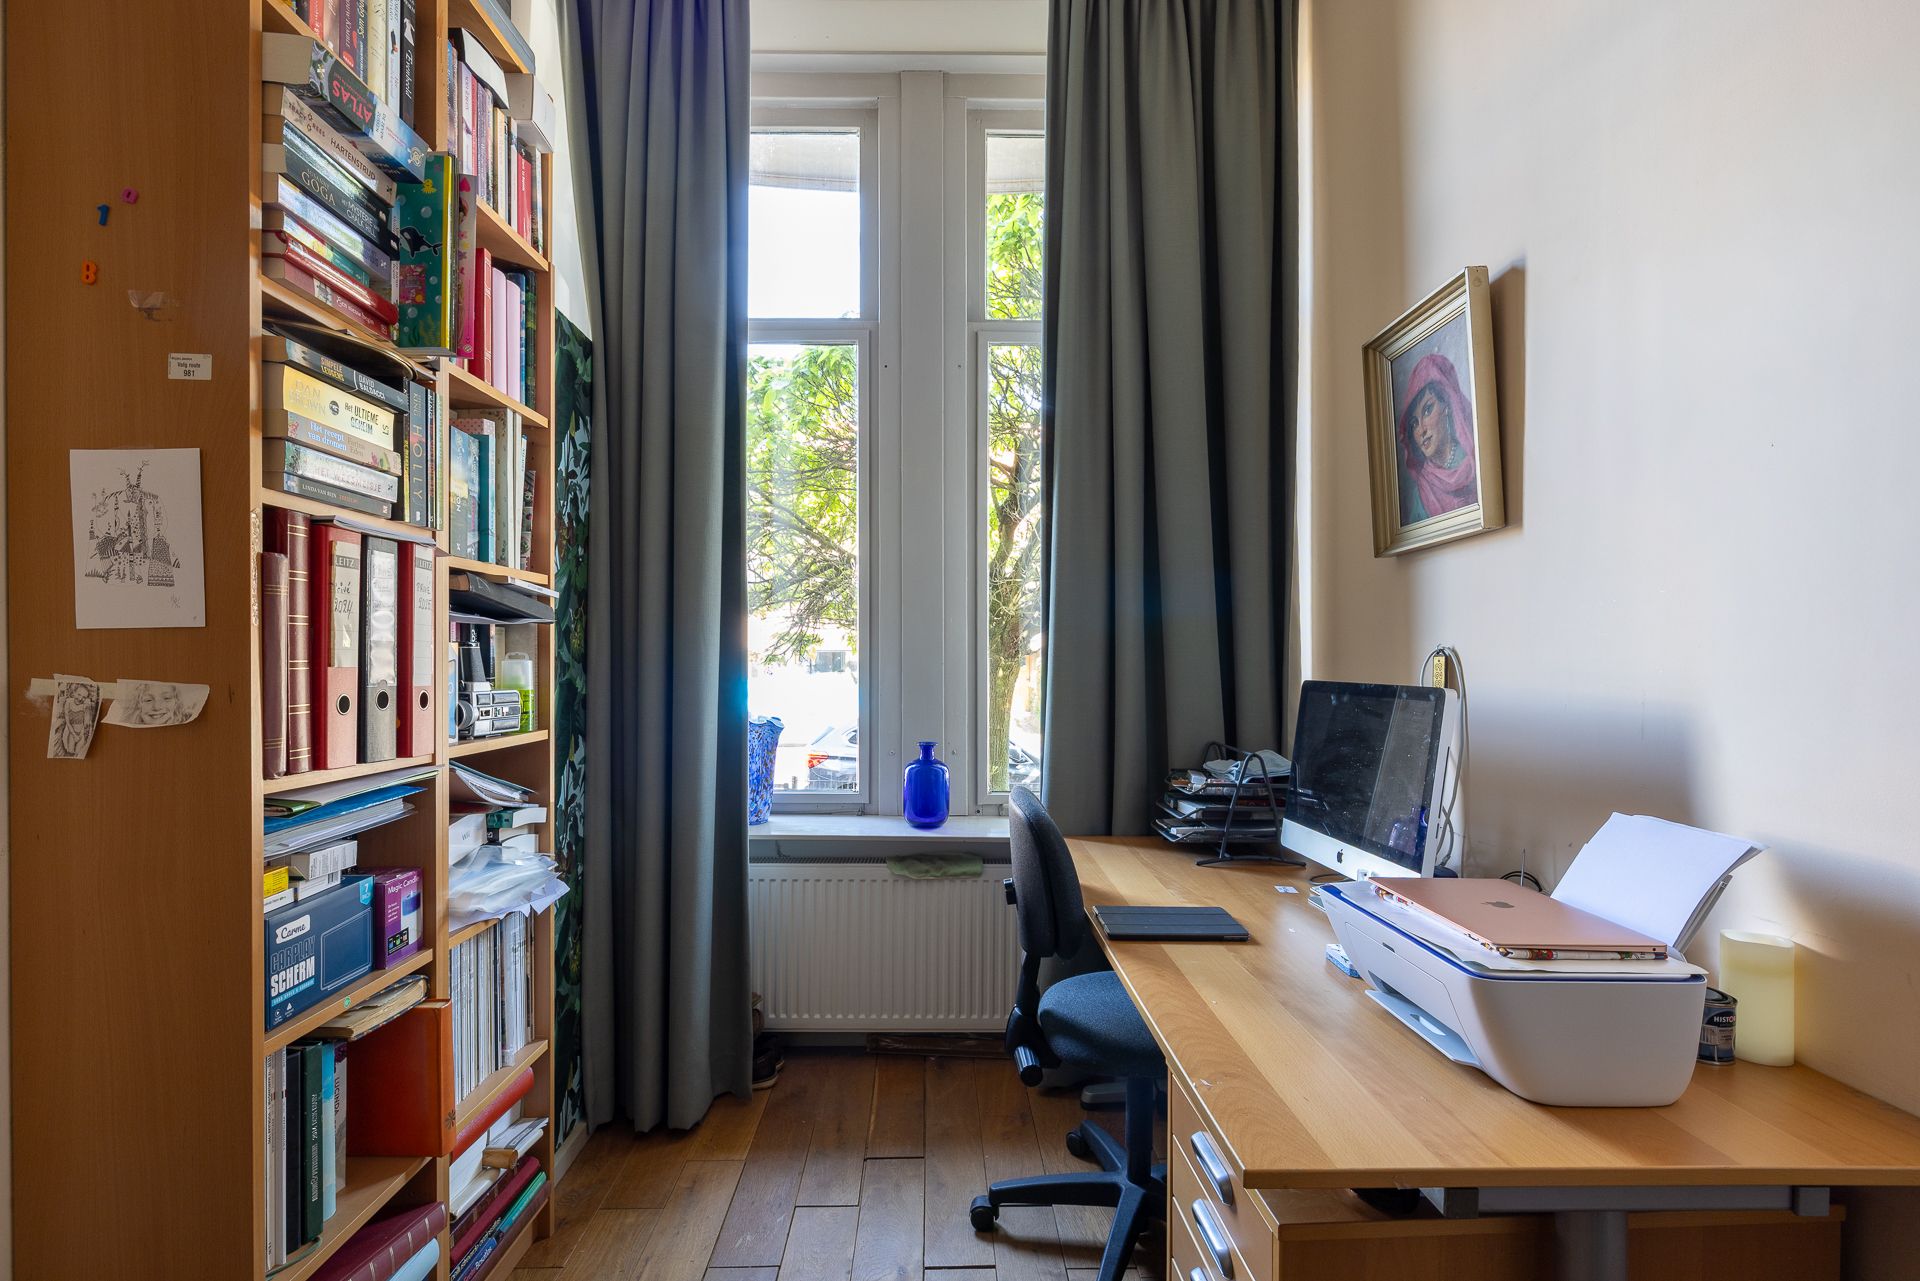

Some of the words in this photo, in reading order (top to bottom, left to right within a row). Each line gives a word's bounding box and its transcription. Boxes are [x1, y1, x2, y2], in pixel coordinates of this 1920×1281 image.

[332, 80, 373, 123] ATLAS
[331, 138, 376, 180] HARTENSTRUD
[301, 172, 337, 206] GOGA
[295, 380, 321, 398] DAN
[358, 375, 375, 388] DAVID
[351, 416, 373, 434] GEHEIM
[354, 405, 379, 425] ULTIEME
[308, 431, 321, 442] van
[322, 436, 347, 451] dromen
[323, 428, 345, 442] recept
[413, 424, 423, 500] HOLLY
[271, 935, 316, 974] CARPLAY
[270, 956, 315, 997] SCHERM
